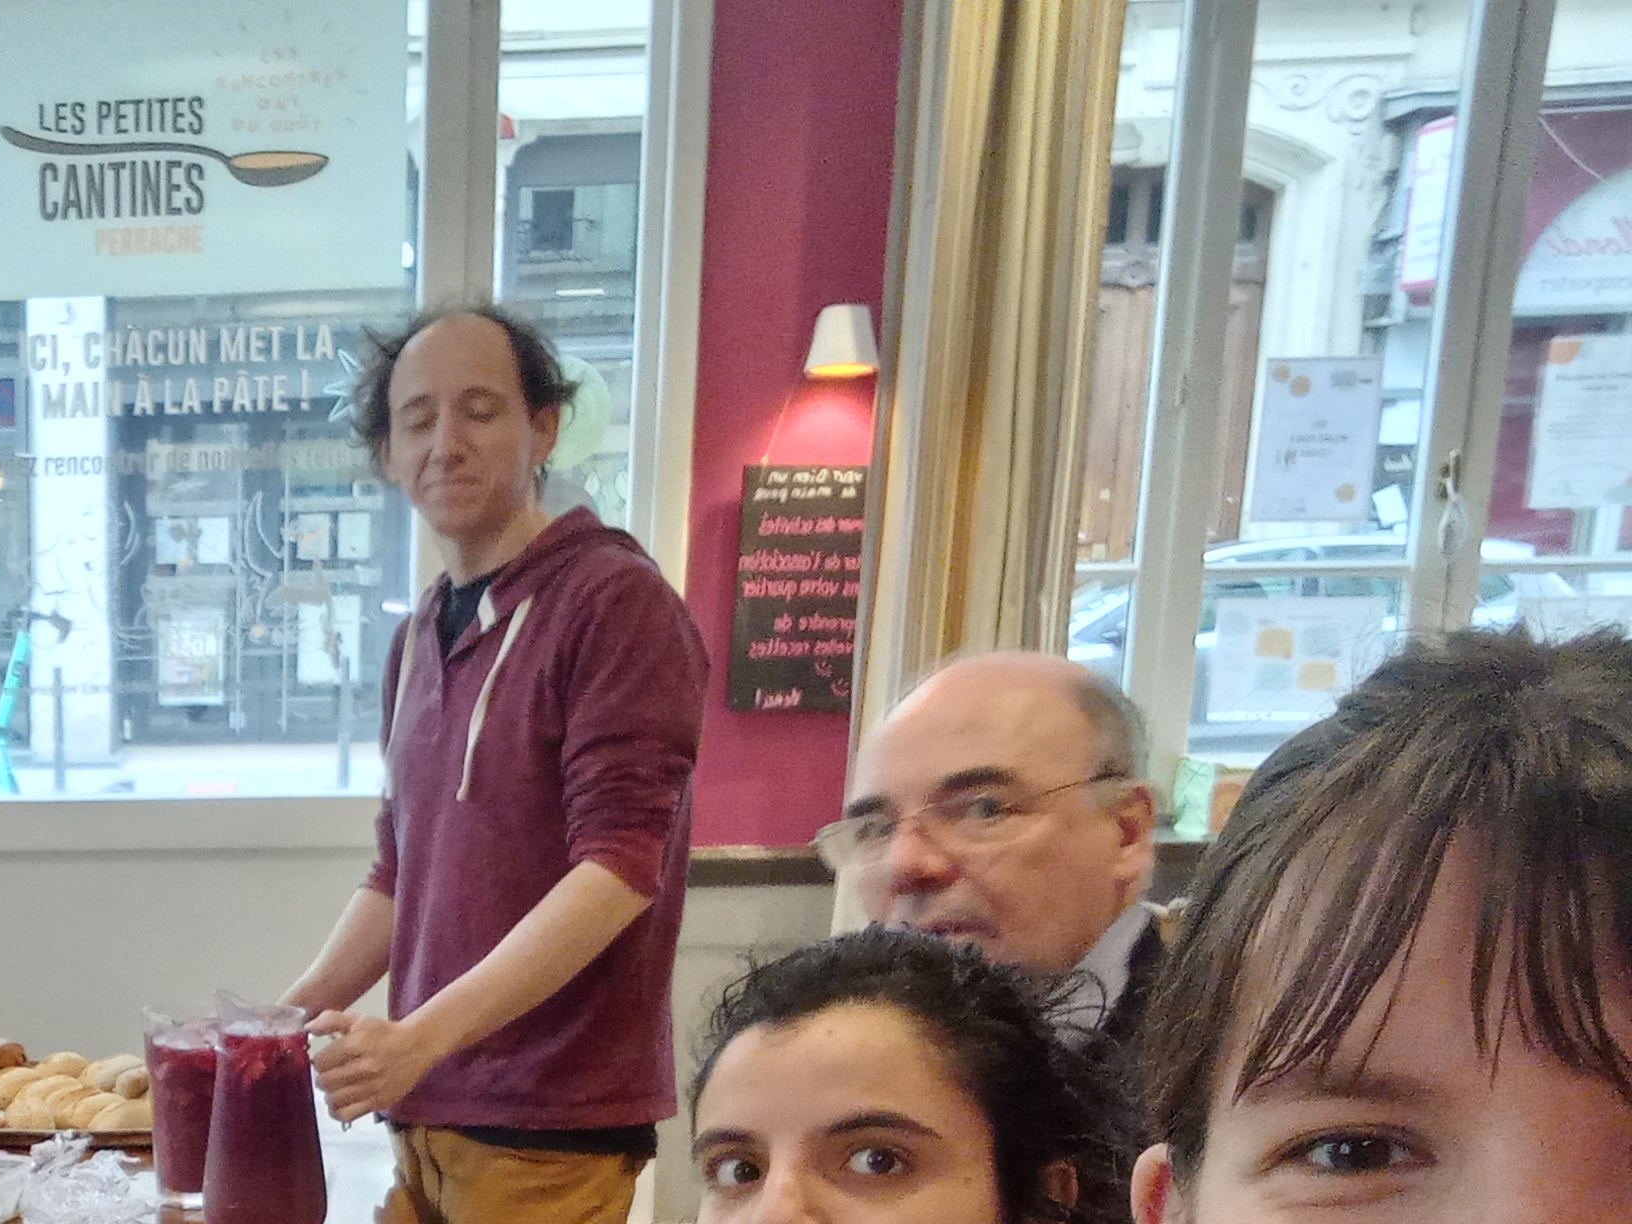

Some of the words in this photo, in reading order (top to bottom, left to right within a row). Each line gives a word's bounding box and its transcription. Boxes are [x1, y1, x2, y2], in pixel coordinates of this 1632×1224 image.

[38, 102, 87, 135] LES
[97, 96, 205, 136] PETITES
[38, 160, 205, 222] CANTINES
[96, 225, 204, 257] PERRACHE
[220, 326, 283, 363] MET
[296, 324, 335, 361] LA
[42, 379, 124, 420] MAIN
[133, 372, 155, 416] À
[164, 378, 201, 415] LA
[213, 369, 290, 414] PÂTE
